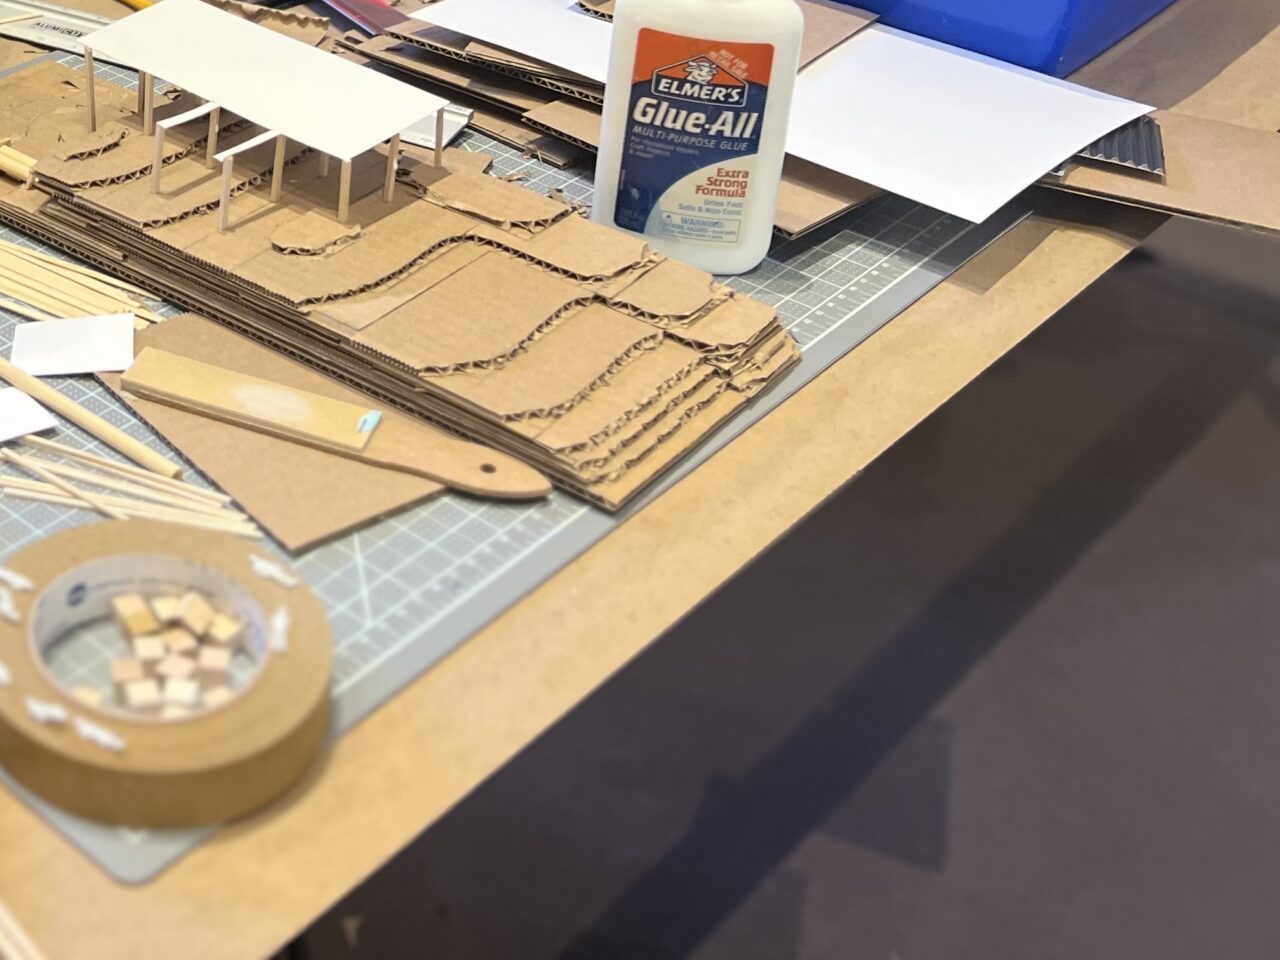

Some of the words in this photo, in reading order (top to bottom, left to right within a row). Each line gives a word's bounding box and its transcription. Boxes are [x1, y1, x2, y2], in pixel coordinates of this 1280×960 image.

[658, 78, 742, 102] ELMER'S
[632, 126, 716, 148] MULTI-PURPOSE
[720, 141, 749, 151] GLUE
[717, 168, 749, 178] Extra
[706, 176, 748, 189] Strong
[695, 185, 746, 198] Formula
[678, 203, 696, 211] Safe
